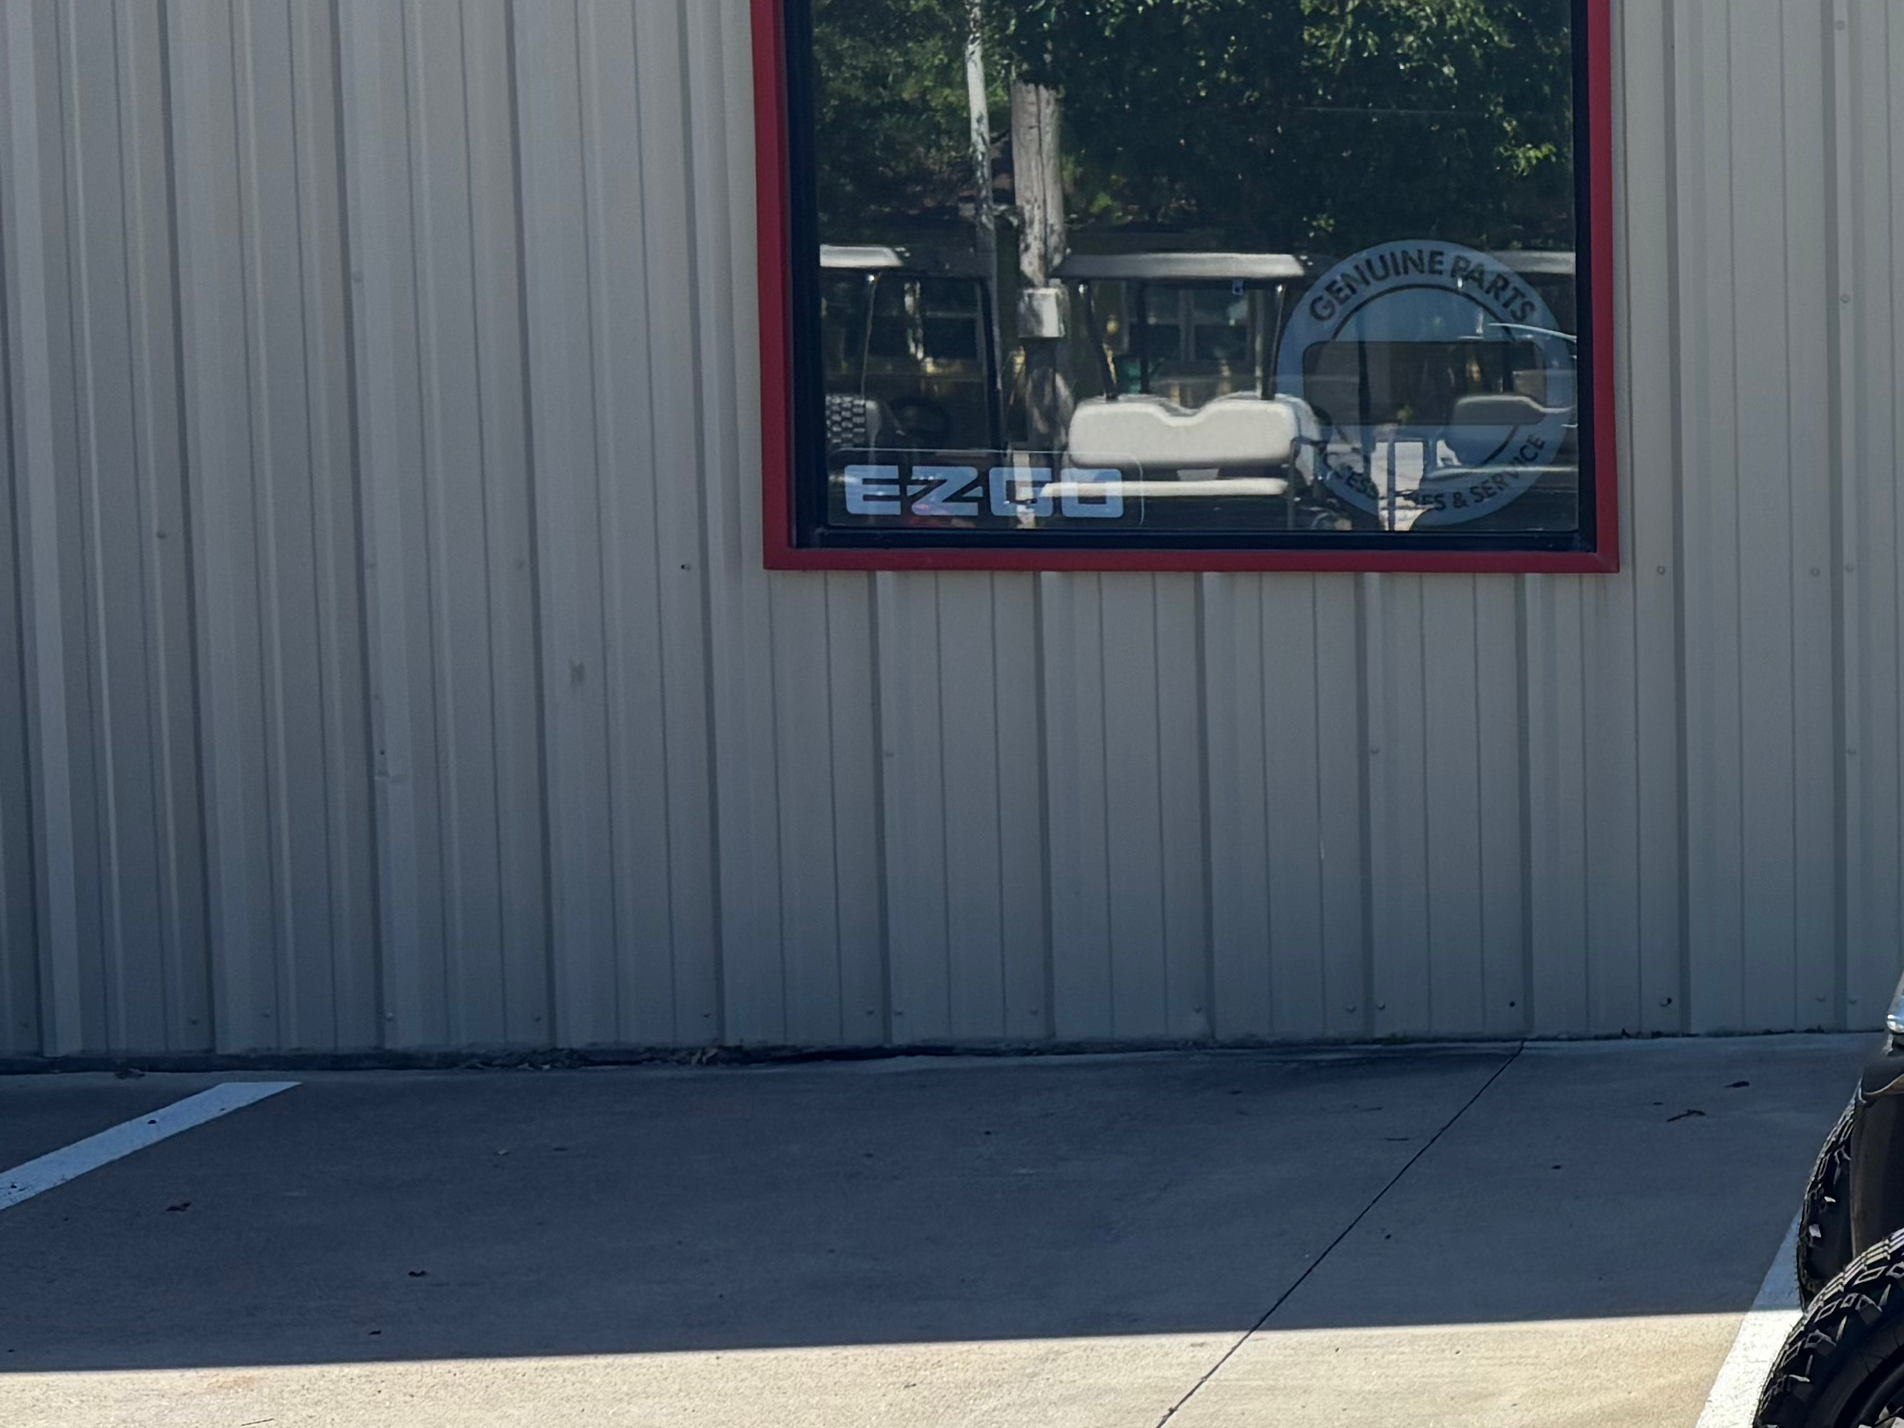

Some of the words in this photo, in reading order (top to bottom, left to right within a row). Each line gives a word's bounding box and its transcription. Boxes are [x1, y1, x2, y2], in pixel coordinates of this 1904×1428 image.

[1309, 248, 1445, 323] GENUINE
[1449, 254, 1537, 323] PARTS
[1452, 490, 1468, 509] &
[1470, 433, 1547, 504] SERVICE
